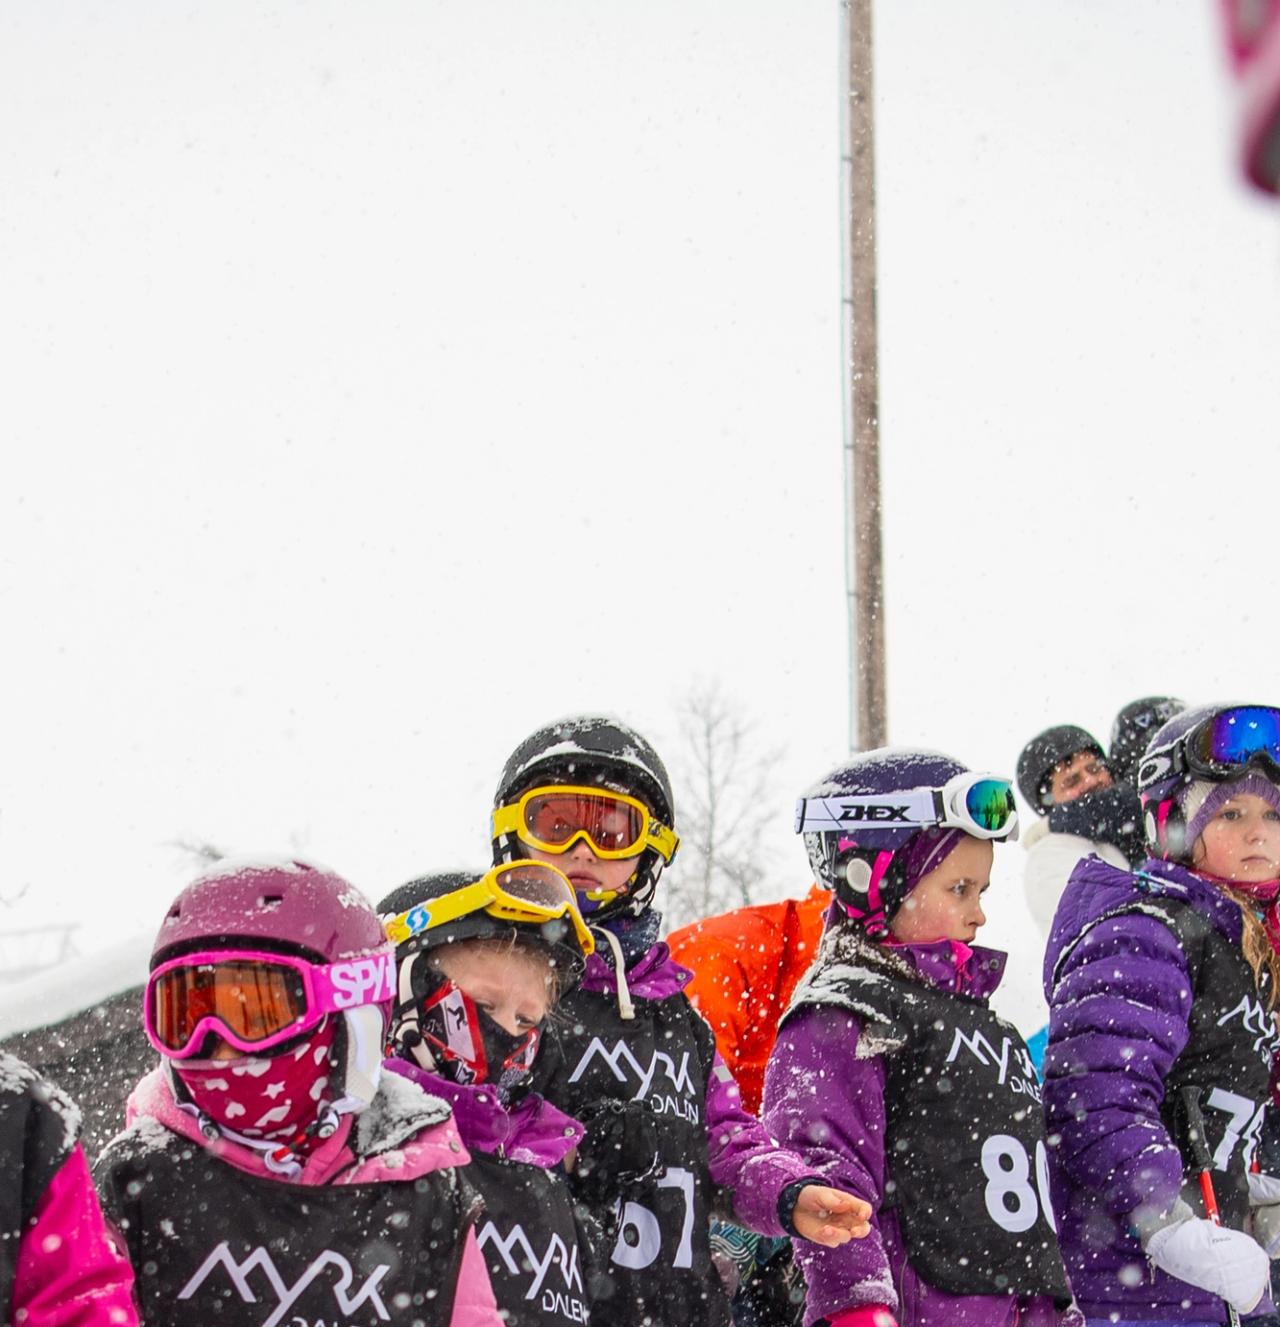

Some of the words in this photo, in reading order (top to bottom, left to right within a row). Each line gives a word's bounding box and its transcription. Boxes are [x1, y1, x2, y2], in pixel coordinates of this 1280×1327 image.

[568, 1037, 696, 1101] MYRK
[477, 1220, 583, 1300] MYRK
[542, 1288, 589, 1326] DALEN
